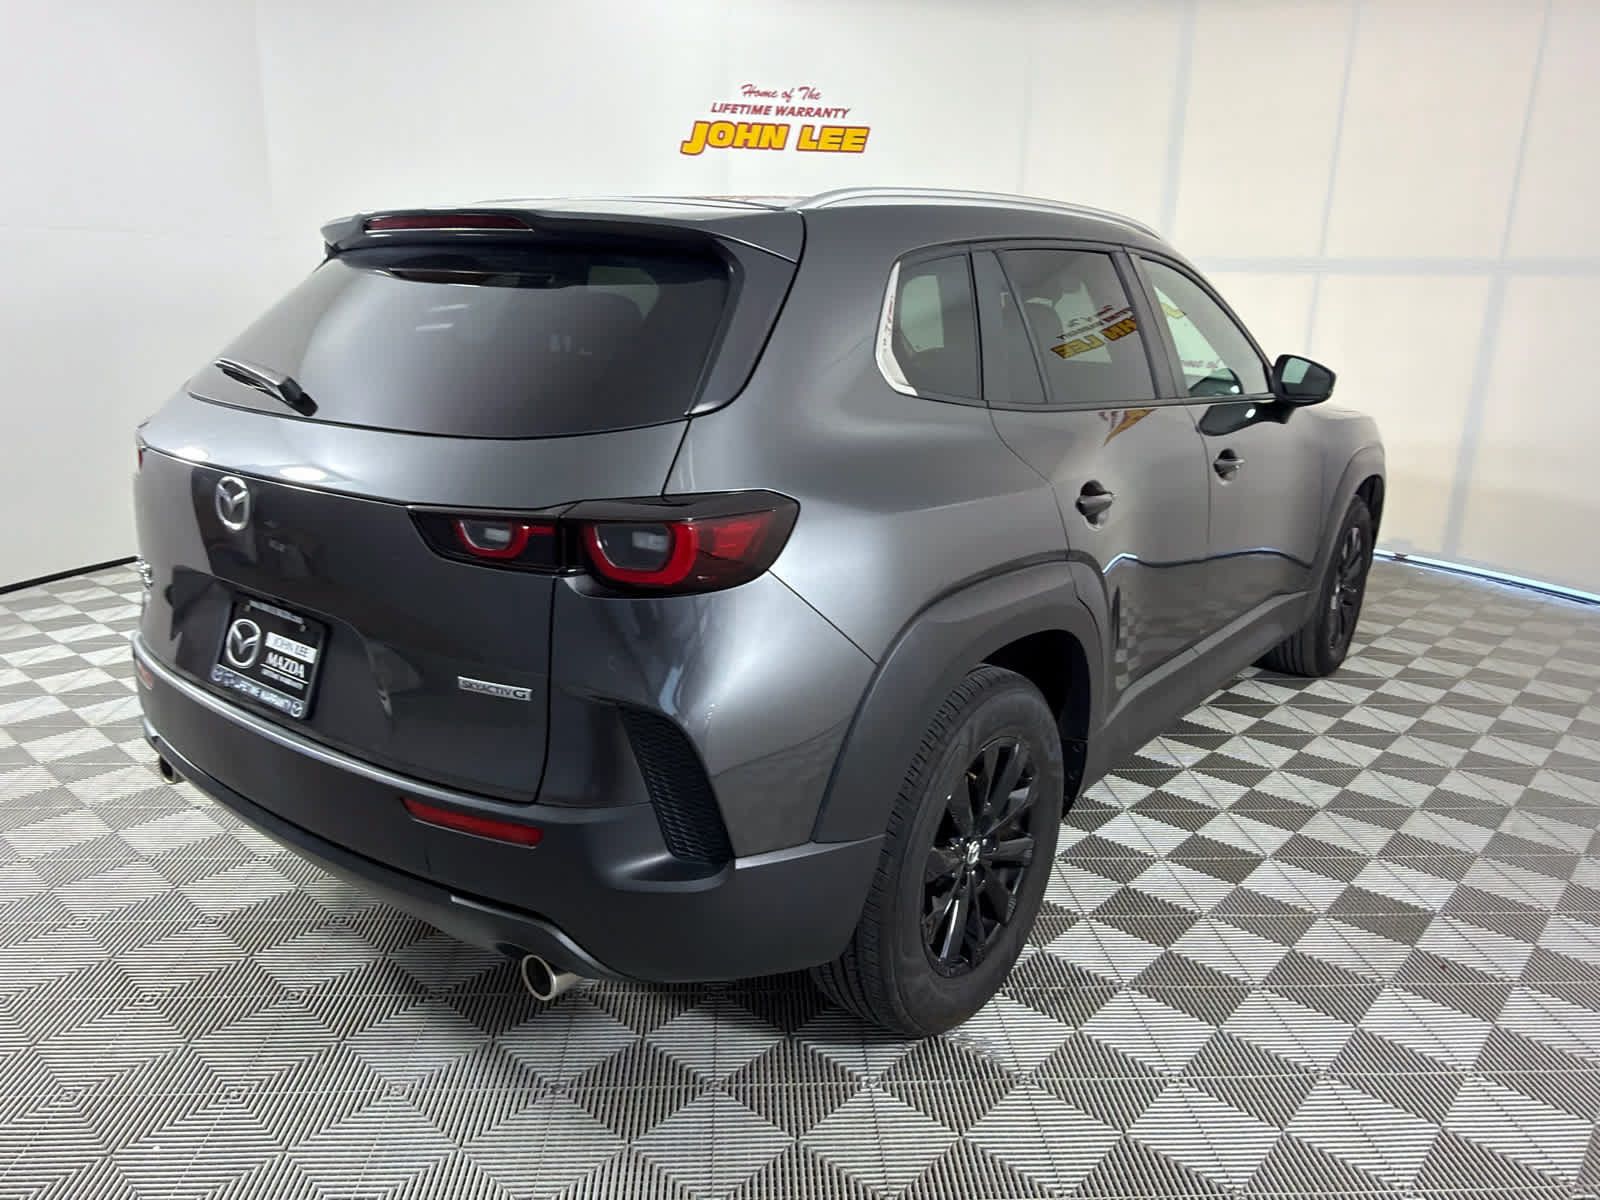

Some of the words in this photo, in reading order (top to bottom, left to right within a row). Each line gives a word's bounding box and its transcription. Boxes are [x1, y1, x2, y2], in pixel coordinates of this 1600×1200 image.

[741, 83, 778, 99] Home
[781, 88, 793, 102] of
[797, 86, 822, 100] The
[711, 102, 773, 116] LIFETIME
[775, 105, 850, 119] WARRANTY
[680, 120, 790, 156] JOHN
[796, 124, 870, 153] LEE
[294, 643, 309, 658] LEE
[266, 651, 305, 678] MAZDA
